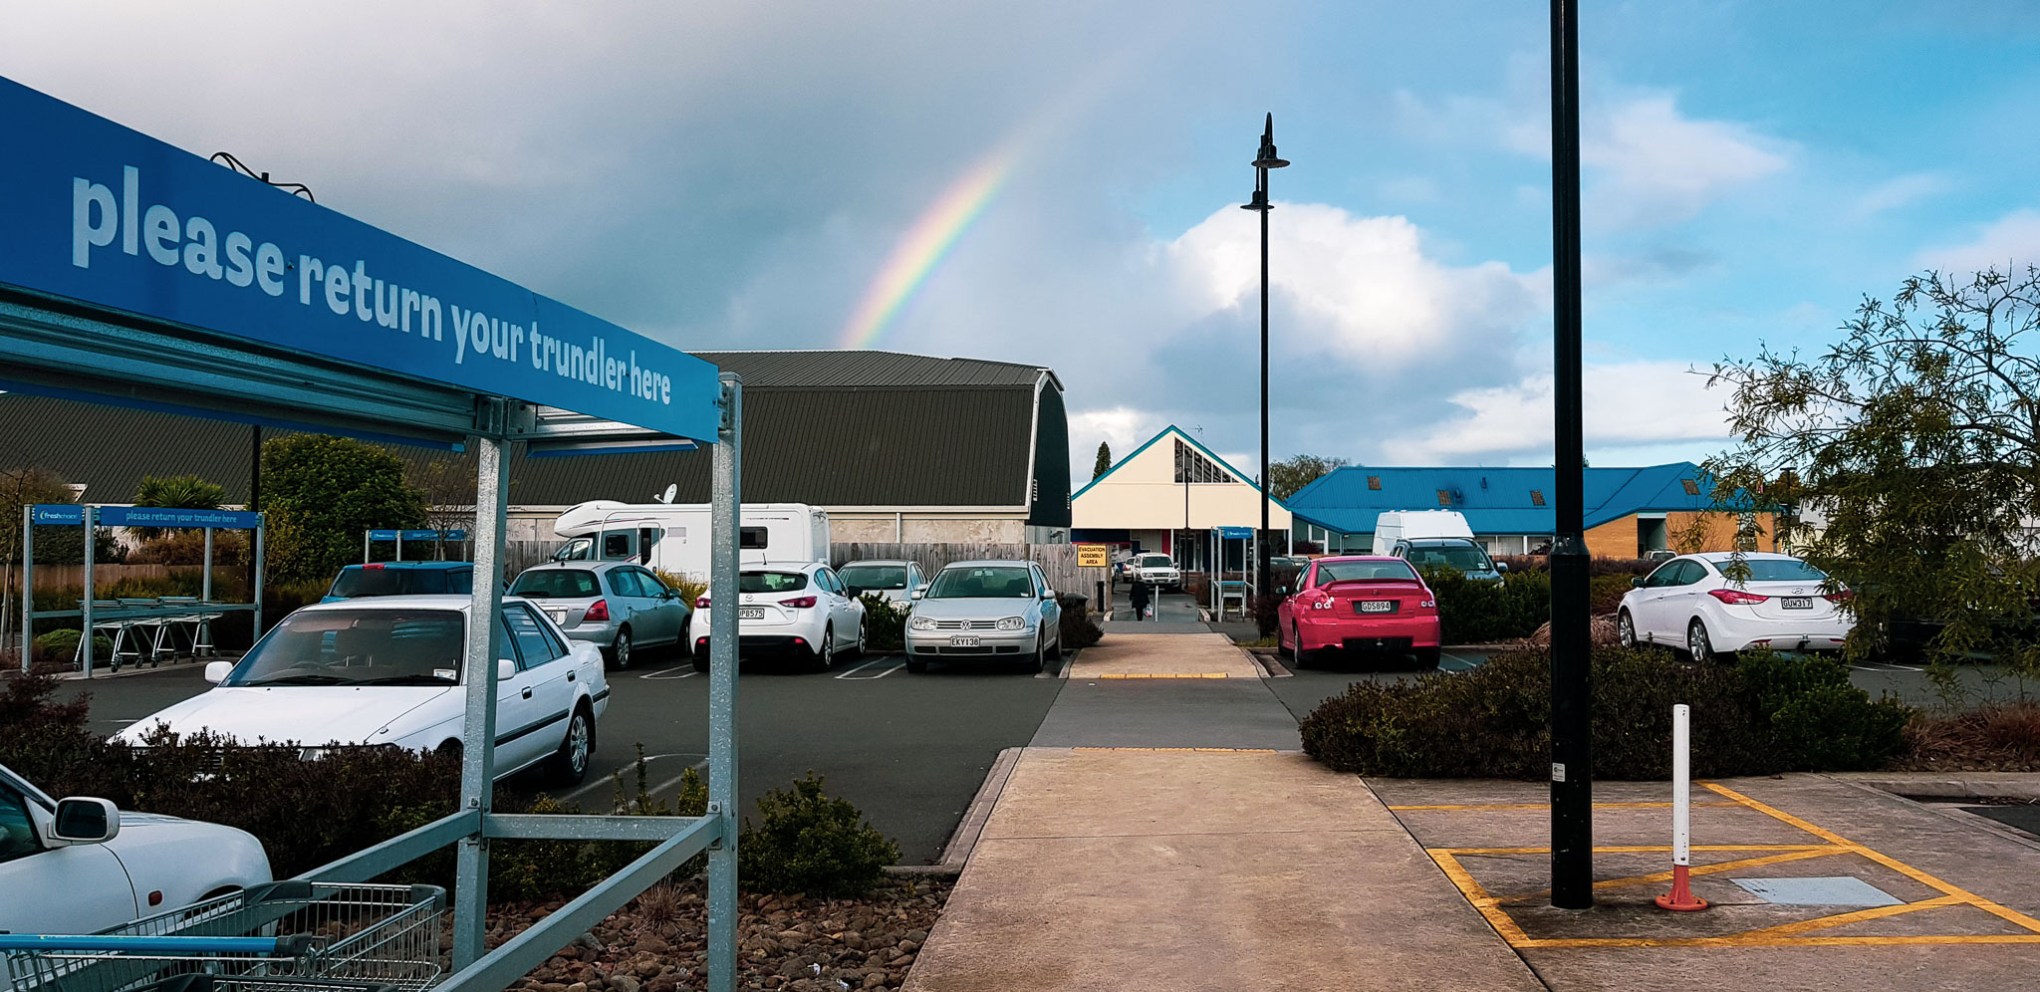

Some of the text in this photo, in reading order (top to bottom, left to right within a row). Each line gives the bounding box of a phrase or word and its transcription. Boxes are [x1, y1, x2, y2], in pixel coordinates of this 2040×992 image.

[73, 164, 671, 405] please return your trundler here
[126, 510, 237, 523] please return your trundler here
